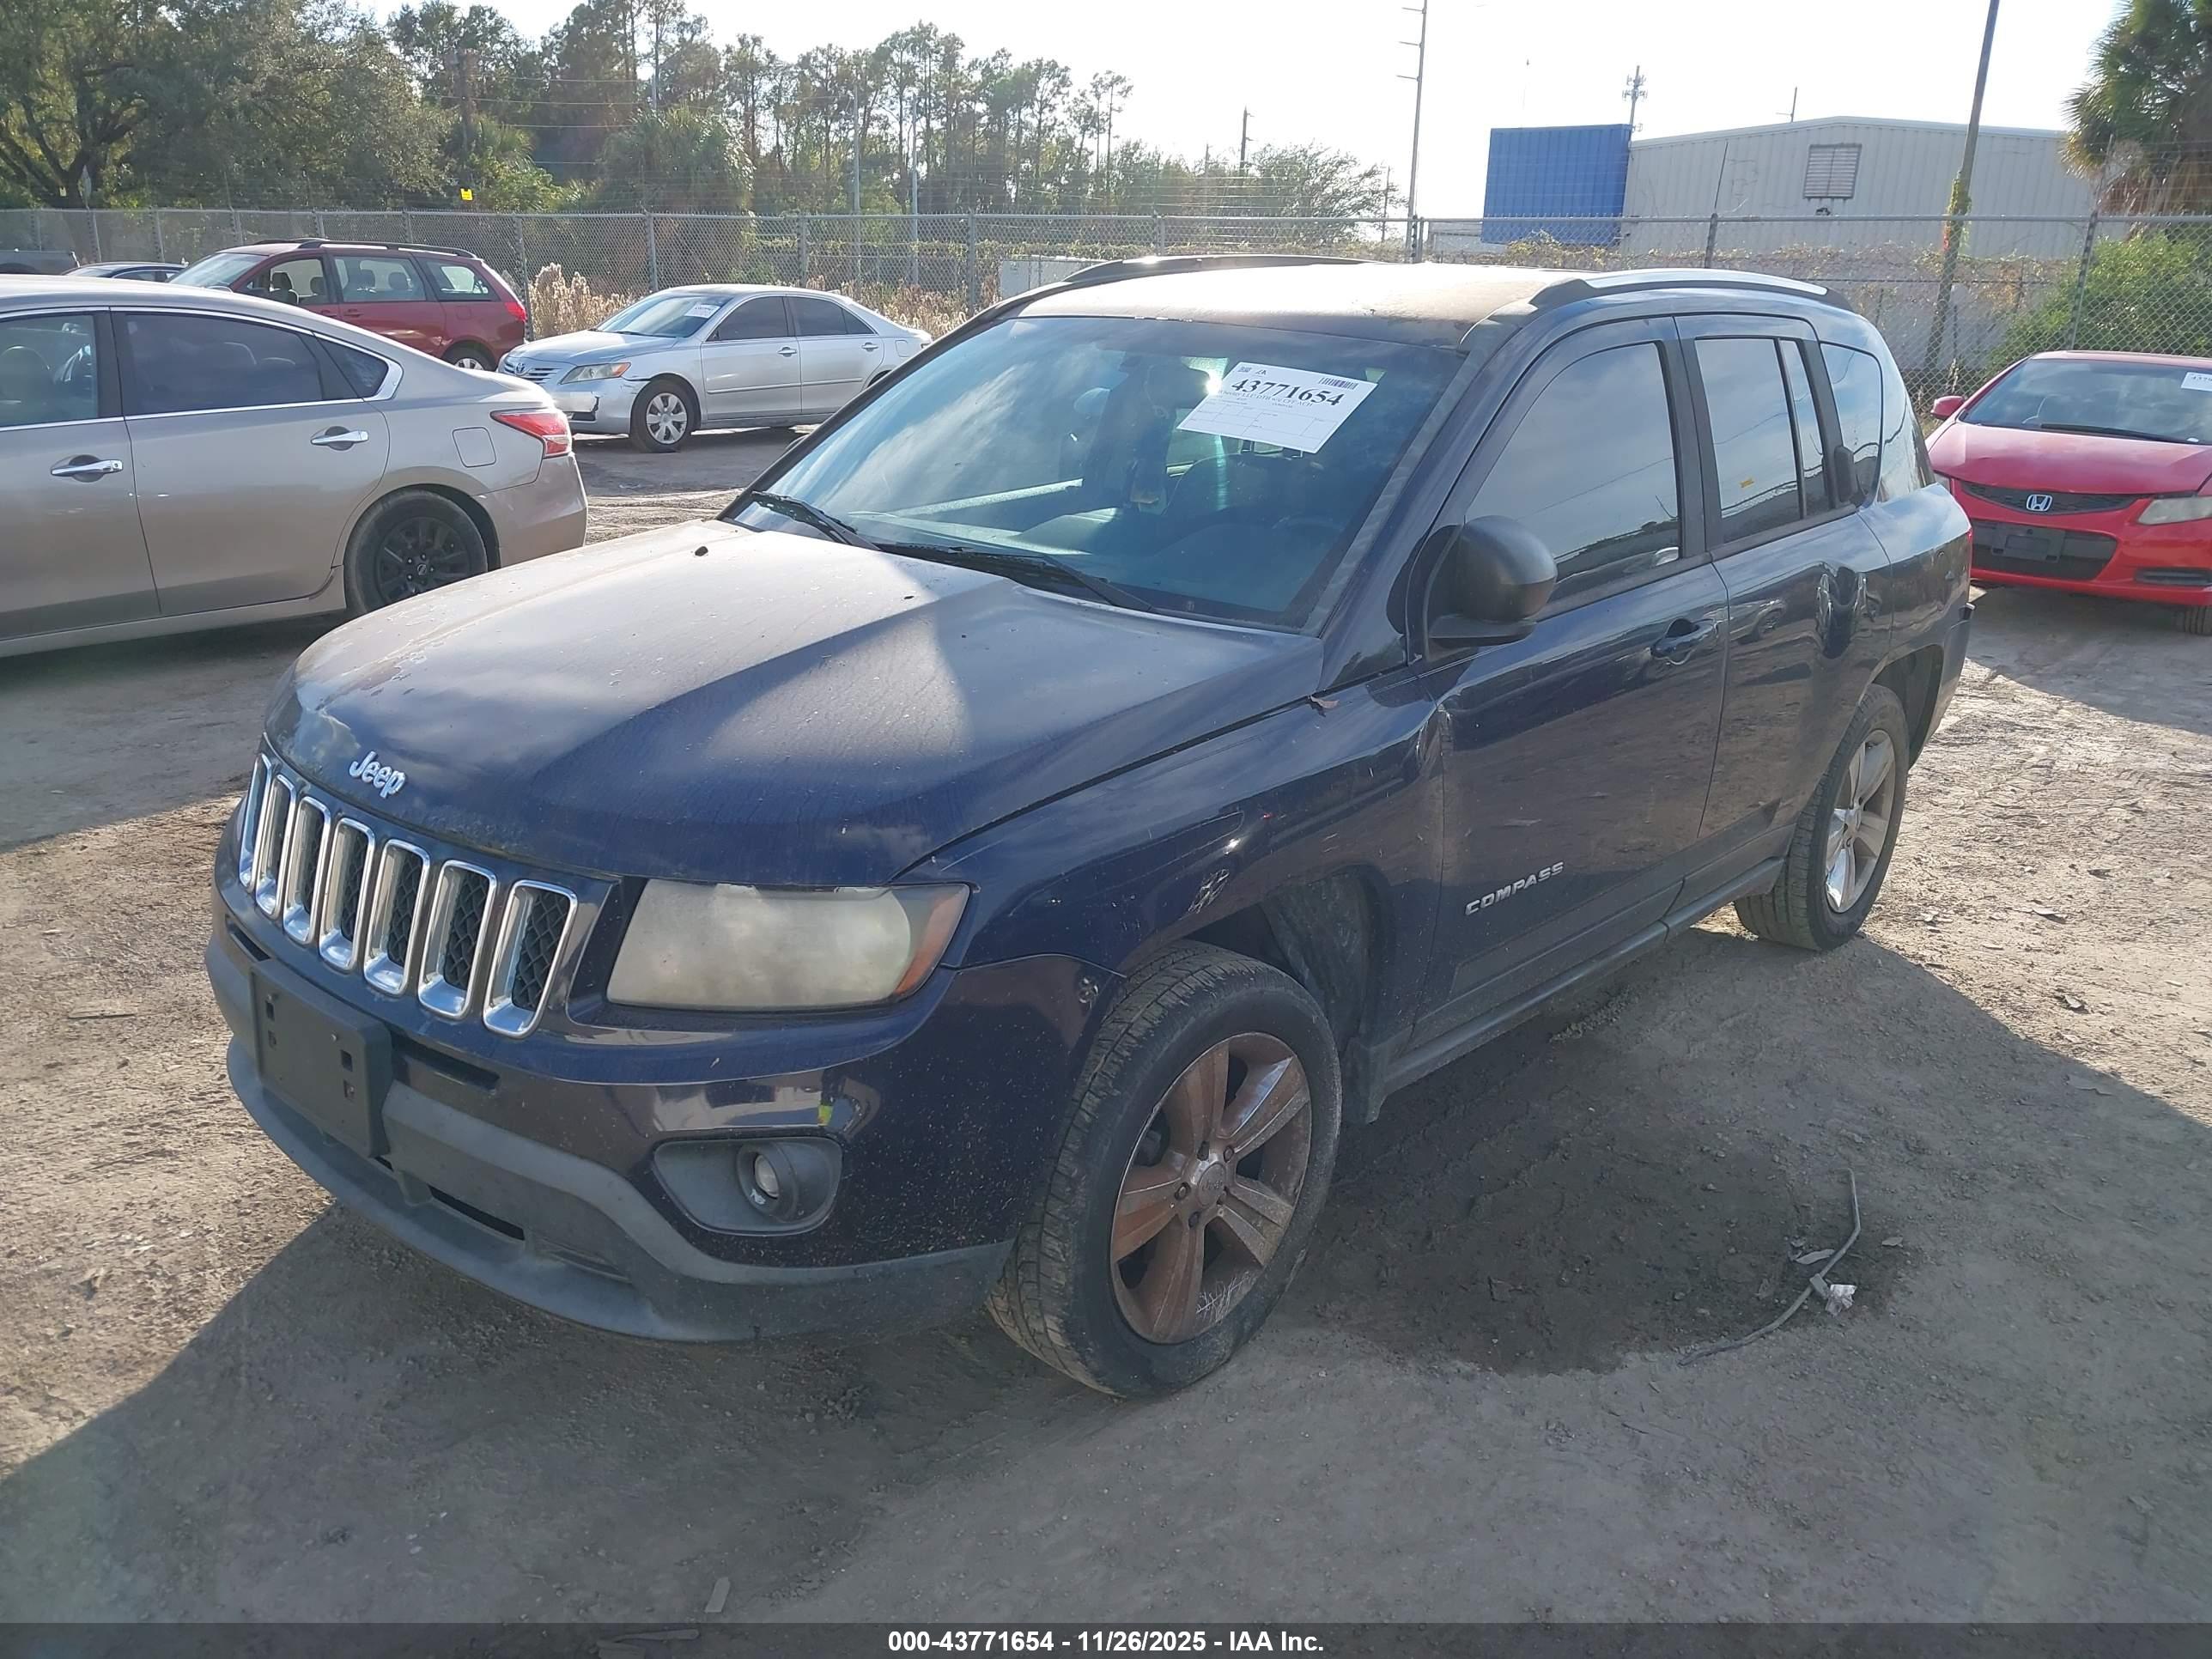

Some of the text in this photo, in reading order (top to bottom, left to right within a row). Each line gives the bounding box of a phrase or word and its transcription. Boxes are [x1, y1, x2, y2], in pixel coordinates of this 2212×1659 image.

[1231, 379, 1345, 405] 43771654
[349, 751, 405, 799] Jeep
[1465, 861, 1564, 915] COMPASS
